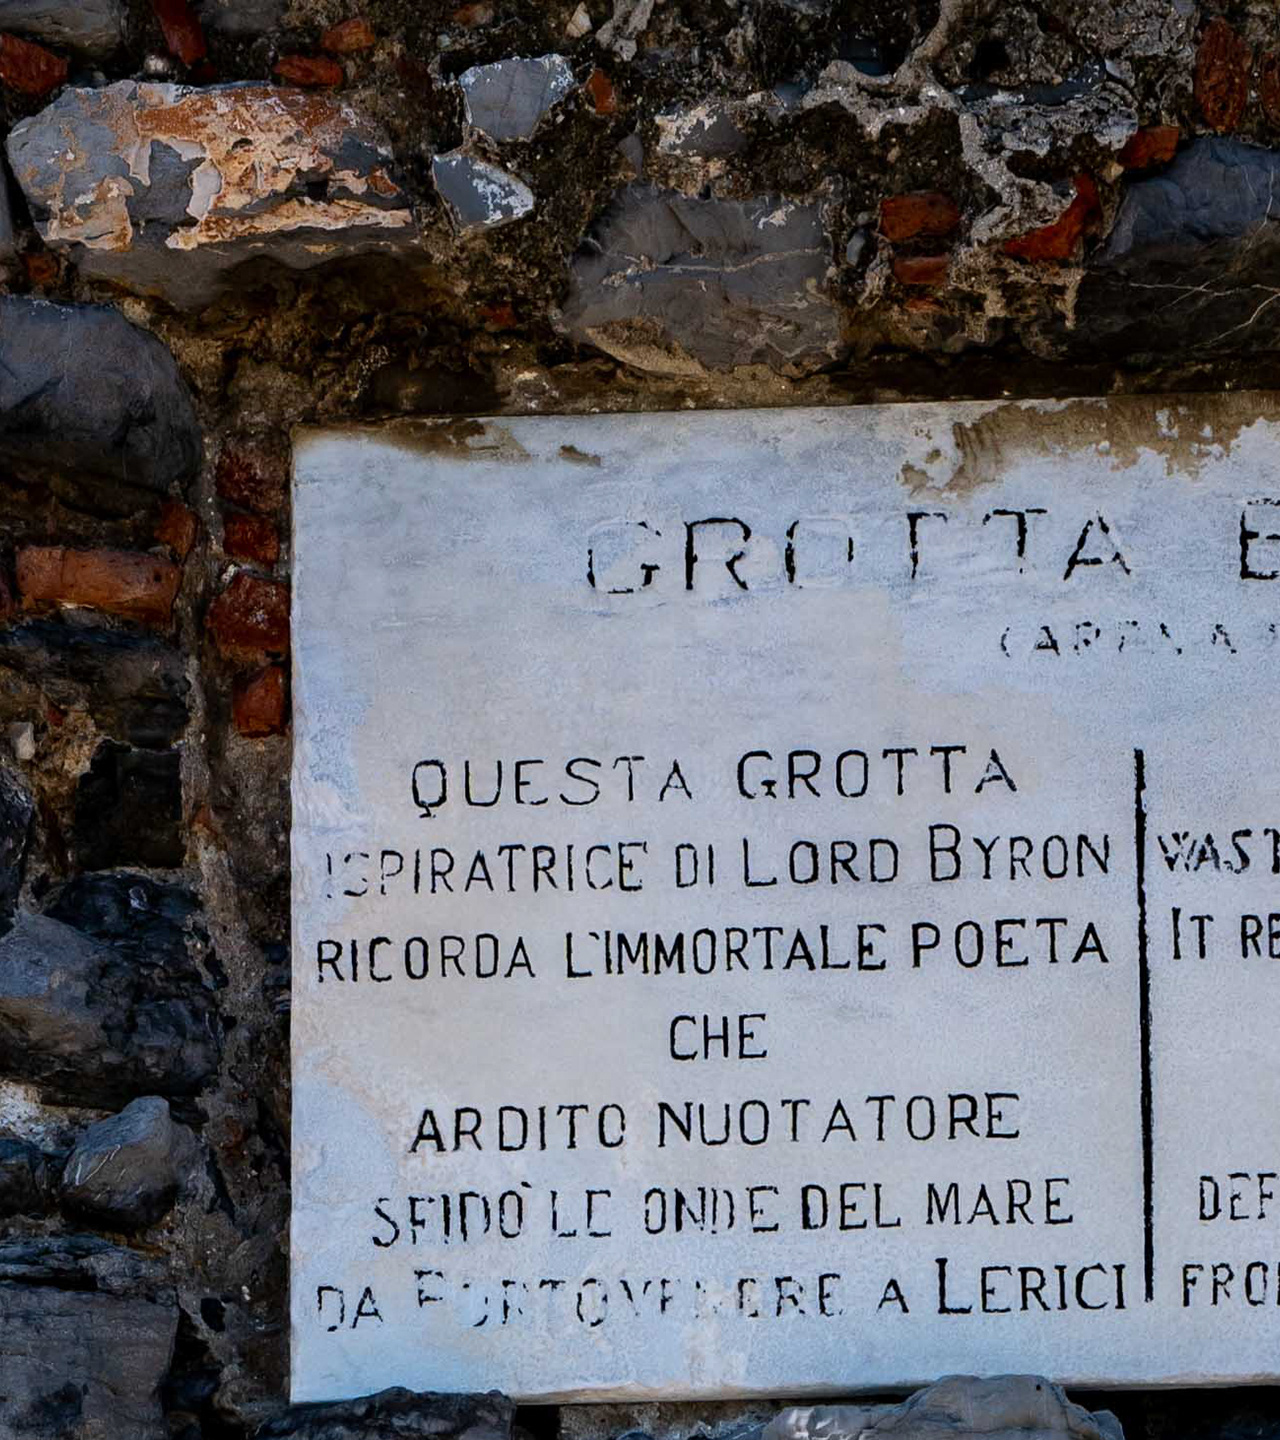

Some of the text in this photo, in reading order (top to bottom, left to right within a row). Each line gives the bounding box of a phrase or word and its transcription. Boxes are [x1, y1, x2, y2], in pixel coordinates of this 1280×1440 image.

[411, 744, 1018, 819] QUESTA GROTTA
[674, 842, 715, 889] DI
[742, 837, 899, 888] LORD
[927, 823, 1110, 883] BYRON
[1157, 828, 1253, 875] WAS
[316, 932, 536, 984] RICORDA
[911, 917, 1110, 969] POETA
[1171, 906, 1215, 961] IT
[669, 1012, 768, 1062] CHE
[407, 1091, 1020, 1154] ARDITO NUOTATORE
[644, 1185, 780, 1235] ONDE
[800, 1182, 902, 1232] DEL
[925, 1177, 1074, 1226] MARE
[316, 1285, 384, 1333] DA
[876, 1277, 910, 1314] A
[934, 1257, 1127, 1315] LERICI
